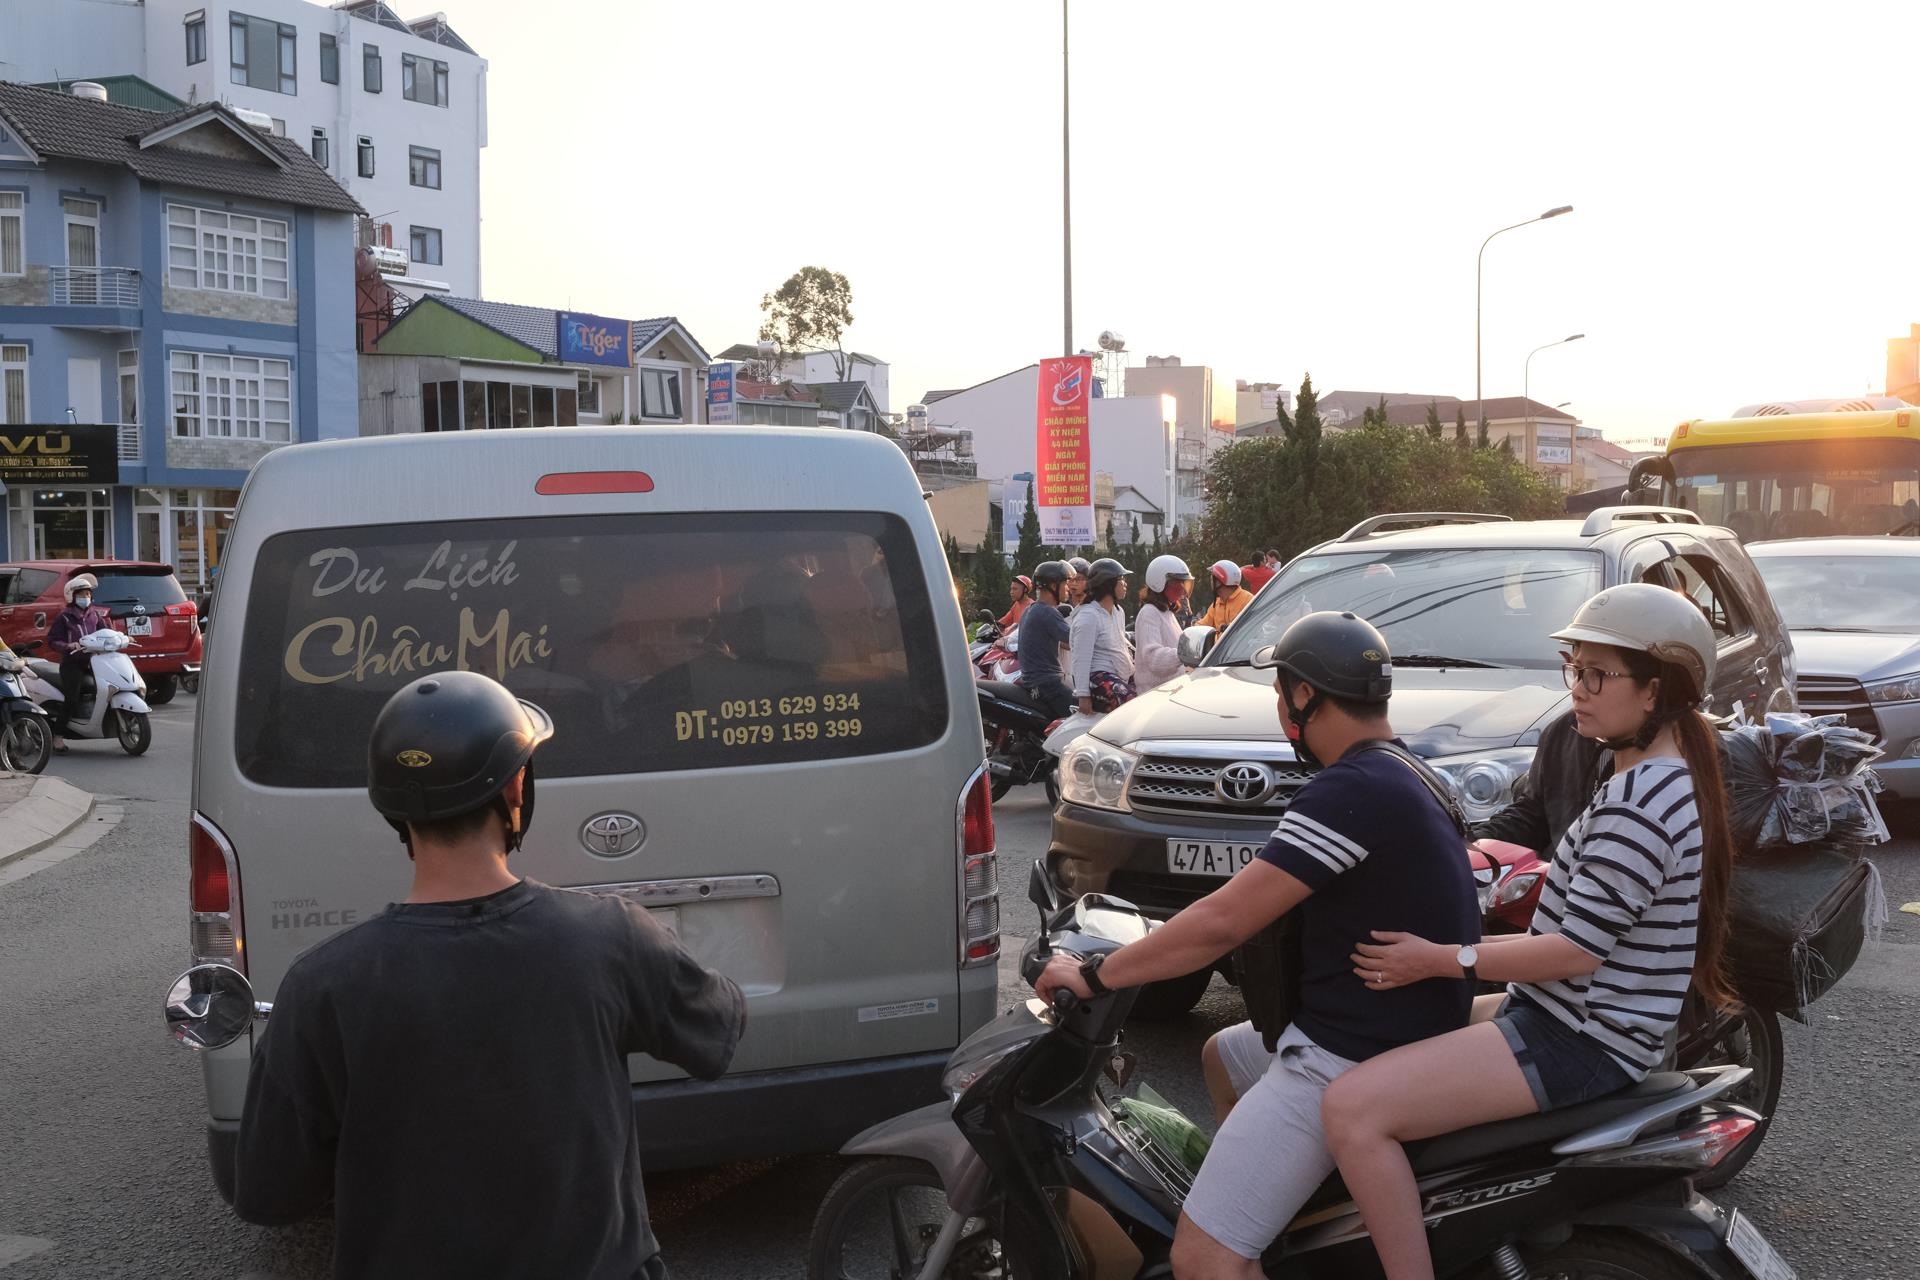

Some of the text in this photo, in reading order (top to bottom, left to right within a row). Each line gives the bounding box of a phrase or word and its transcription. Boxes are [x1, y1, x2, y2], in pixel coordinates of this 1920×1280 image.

[578, 326, 622, 357] Tiger
[1044, 416, 1087, 426] CHÀO MỪNG
[1050, 427, 1081, 438] KỶ NIỆM
[0, 430, 71, 454] VŨ
[1062, 438, 1081, 448] NĂM
[1055, 450, 1077, 460] NGÀY
[1044, 461, 1086, 471] GIẢI PHÓNG
[1046, 472, 1086, 482] MIỀN NAM
[1043, 483, 1088, 494] THỐNG NHẤT
[1048, 495, 1085, 505] ĐẤT NƯỚC
[309, 539, 520, 601] Du Lịch
[284, 606, 552, 684] Châu Mai
[675, 692, 861, 741] ĐT: 0913 629 934
[722, 718, 862, 746] 0979 159 399
[271, 898, 321, 910] TOYOTA
[271, 909, 357, 930] HIACE
[1423, 1171, 1557, 1213] FUTURE
